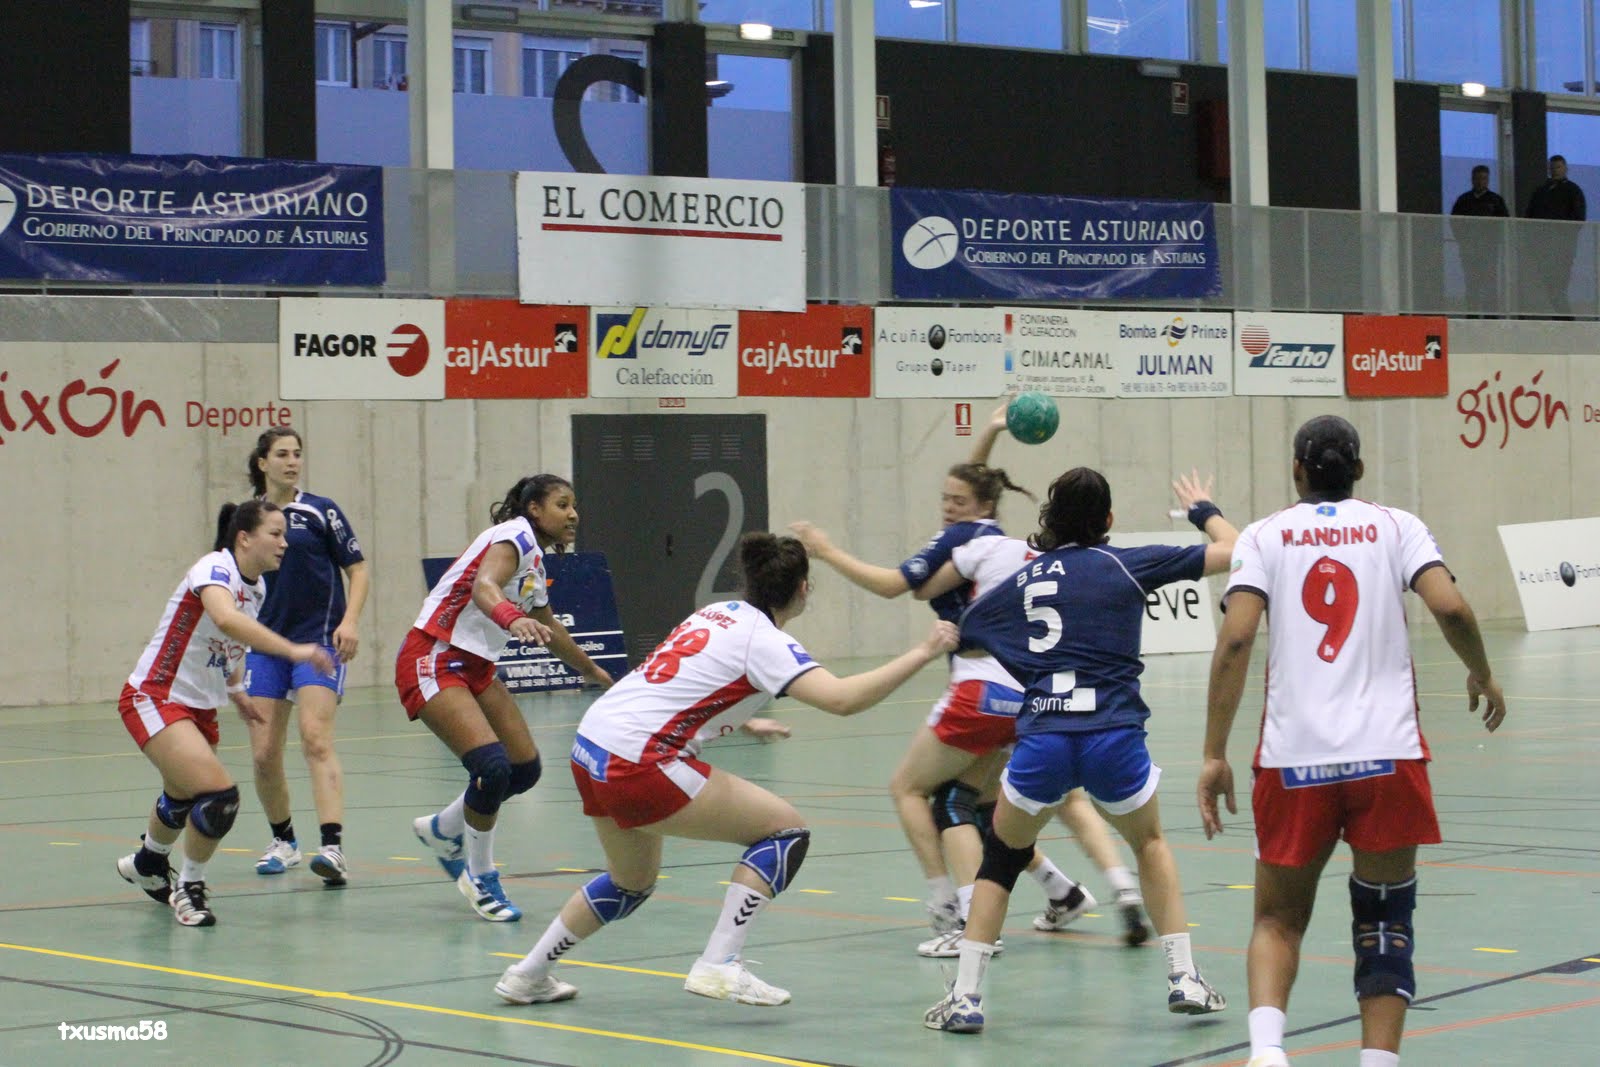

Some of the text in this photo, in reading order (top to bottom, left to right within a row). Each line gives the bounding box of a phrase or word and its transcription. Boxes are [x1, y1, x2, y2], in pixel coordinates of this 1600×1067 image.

[26, 184, 368, 217] DEPORTE ASTURIANO
[542, 185, 783, 229] EL COMERCIO
[23, 216, 368, 246] GOBIERNO DEL PRINCIPADO DE ASTURIAS
[962, 217, 1205, 242] DEPORTE ASTURIANO
[294, 333, 377, 358] FAGOR
[878, 327, 1002, 344] Acuña Fombona
[1119, 323, 1228, 339] Bomba Prinze
[444, 340, 553, 375] cajAstur
[742, 344, 841, 375] cajAstur
[896, 360, 977, 375] Grupo Taper
[1136, 354, 1213, 376] JULMAN
[1352, 348, 1426, 377] cajAstur
[615, 366, 714, 387] Calefacción
[0, 358, 292, 445] ixón Deporte
[1457, 370, 1569, 449] gijón
[694, 471, 747, 612] 2
[1281, 524, 1378, 547] M.ANDINO
[1016, 559, 1067, 588] BEA
[1023, 580, 1063, 653] 5
[1301, 555, 1360, 664] 9
